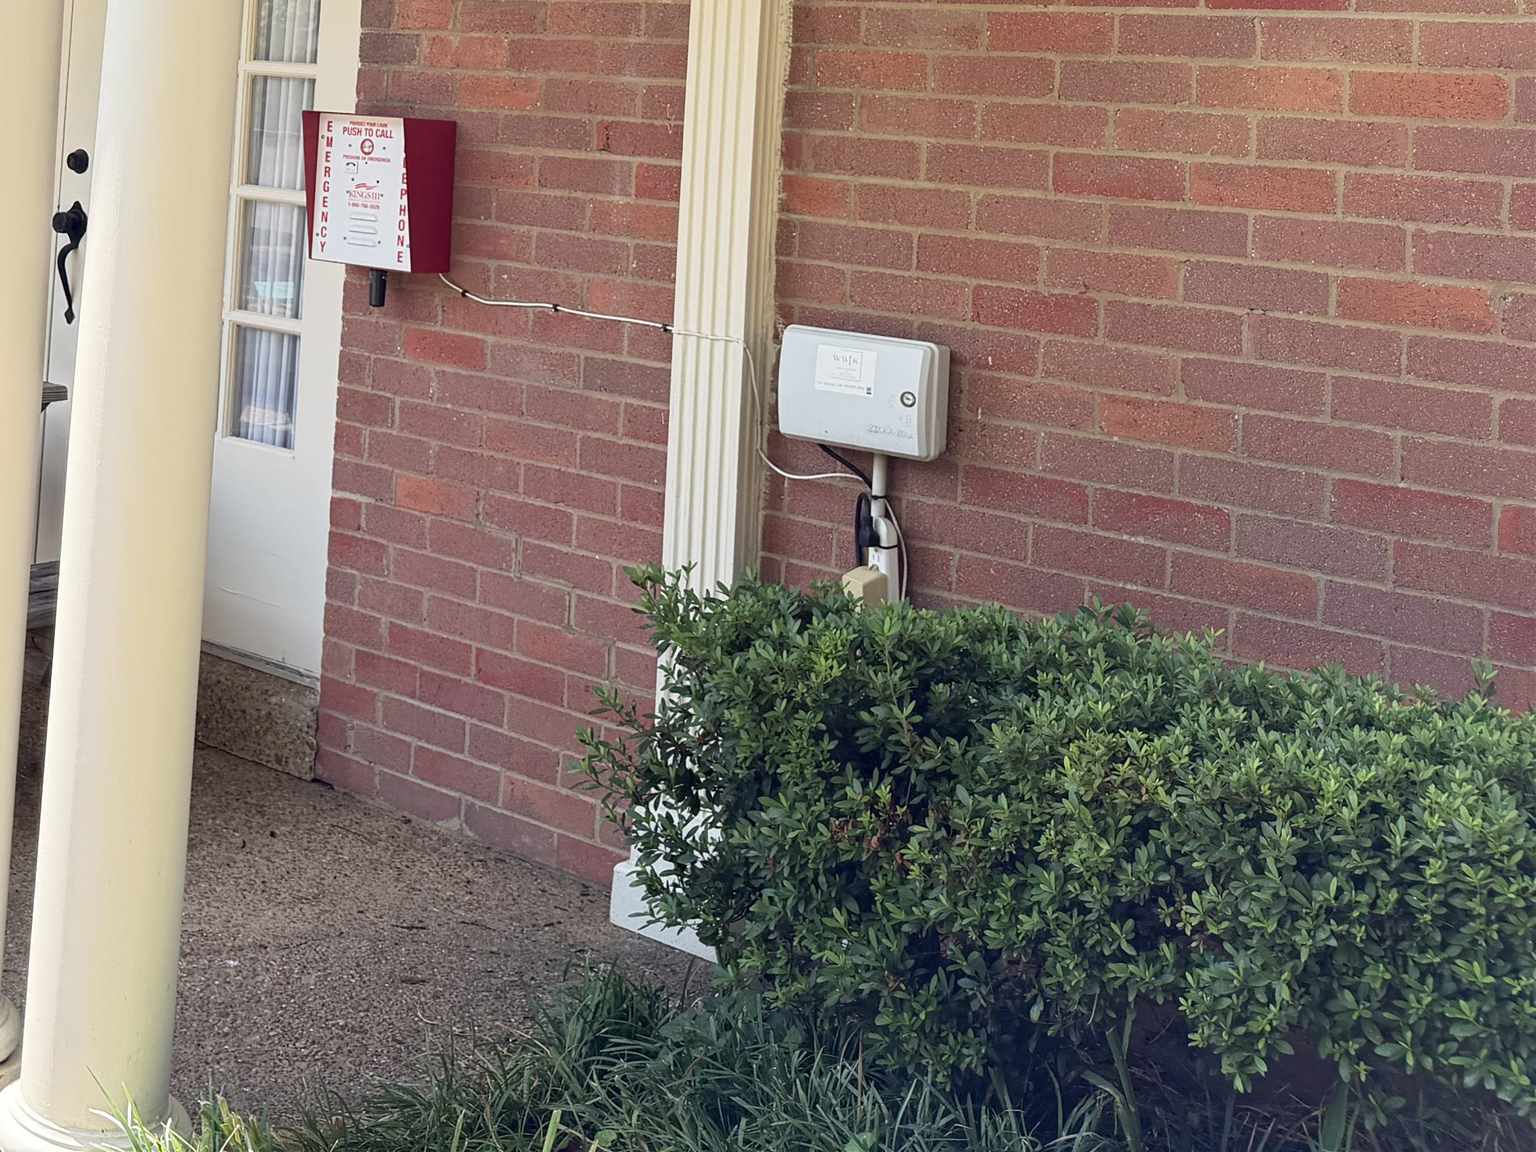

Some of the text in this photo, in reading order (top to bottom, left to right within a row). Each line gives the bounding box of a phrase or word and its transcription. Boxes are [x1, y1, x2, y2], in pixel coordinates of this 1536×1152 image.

[343, 126, 393, 139] PUSH TO CALL
[320, 120, 333, 253] EMERGENCY
[397, 172, 408, 263] EPHONE
